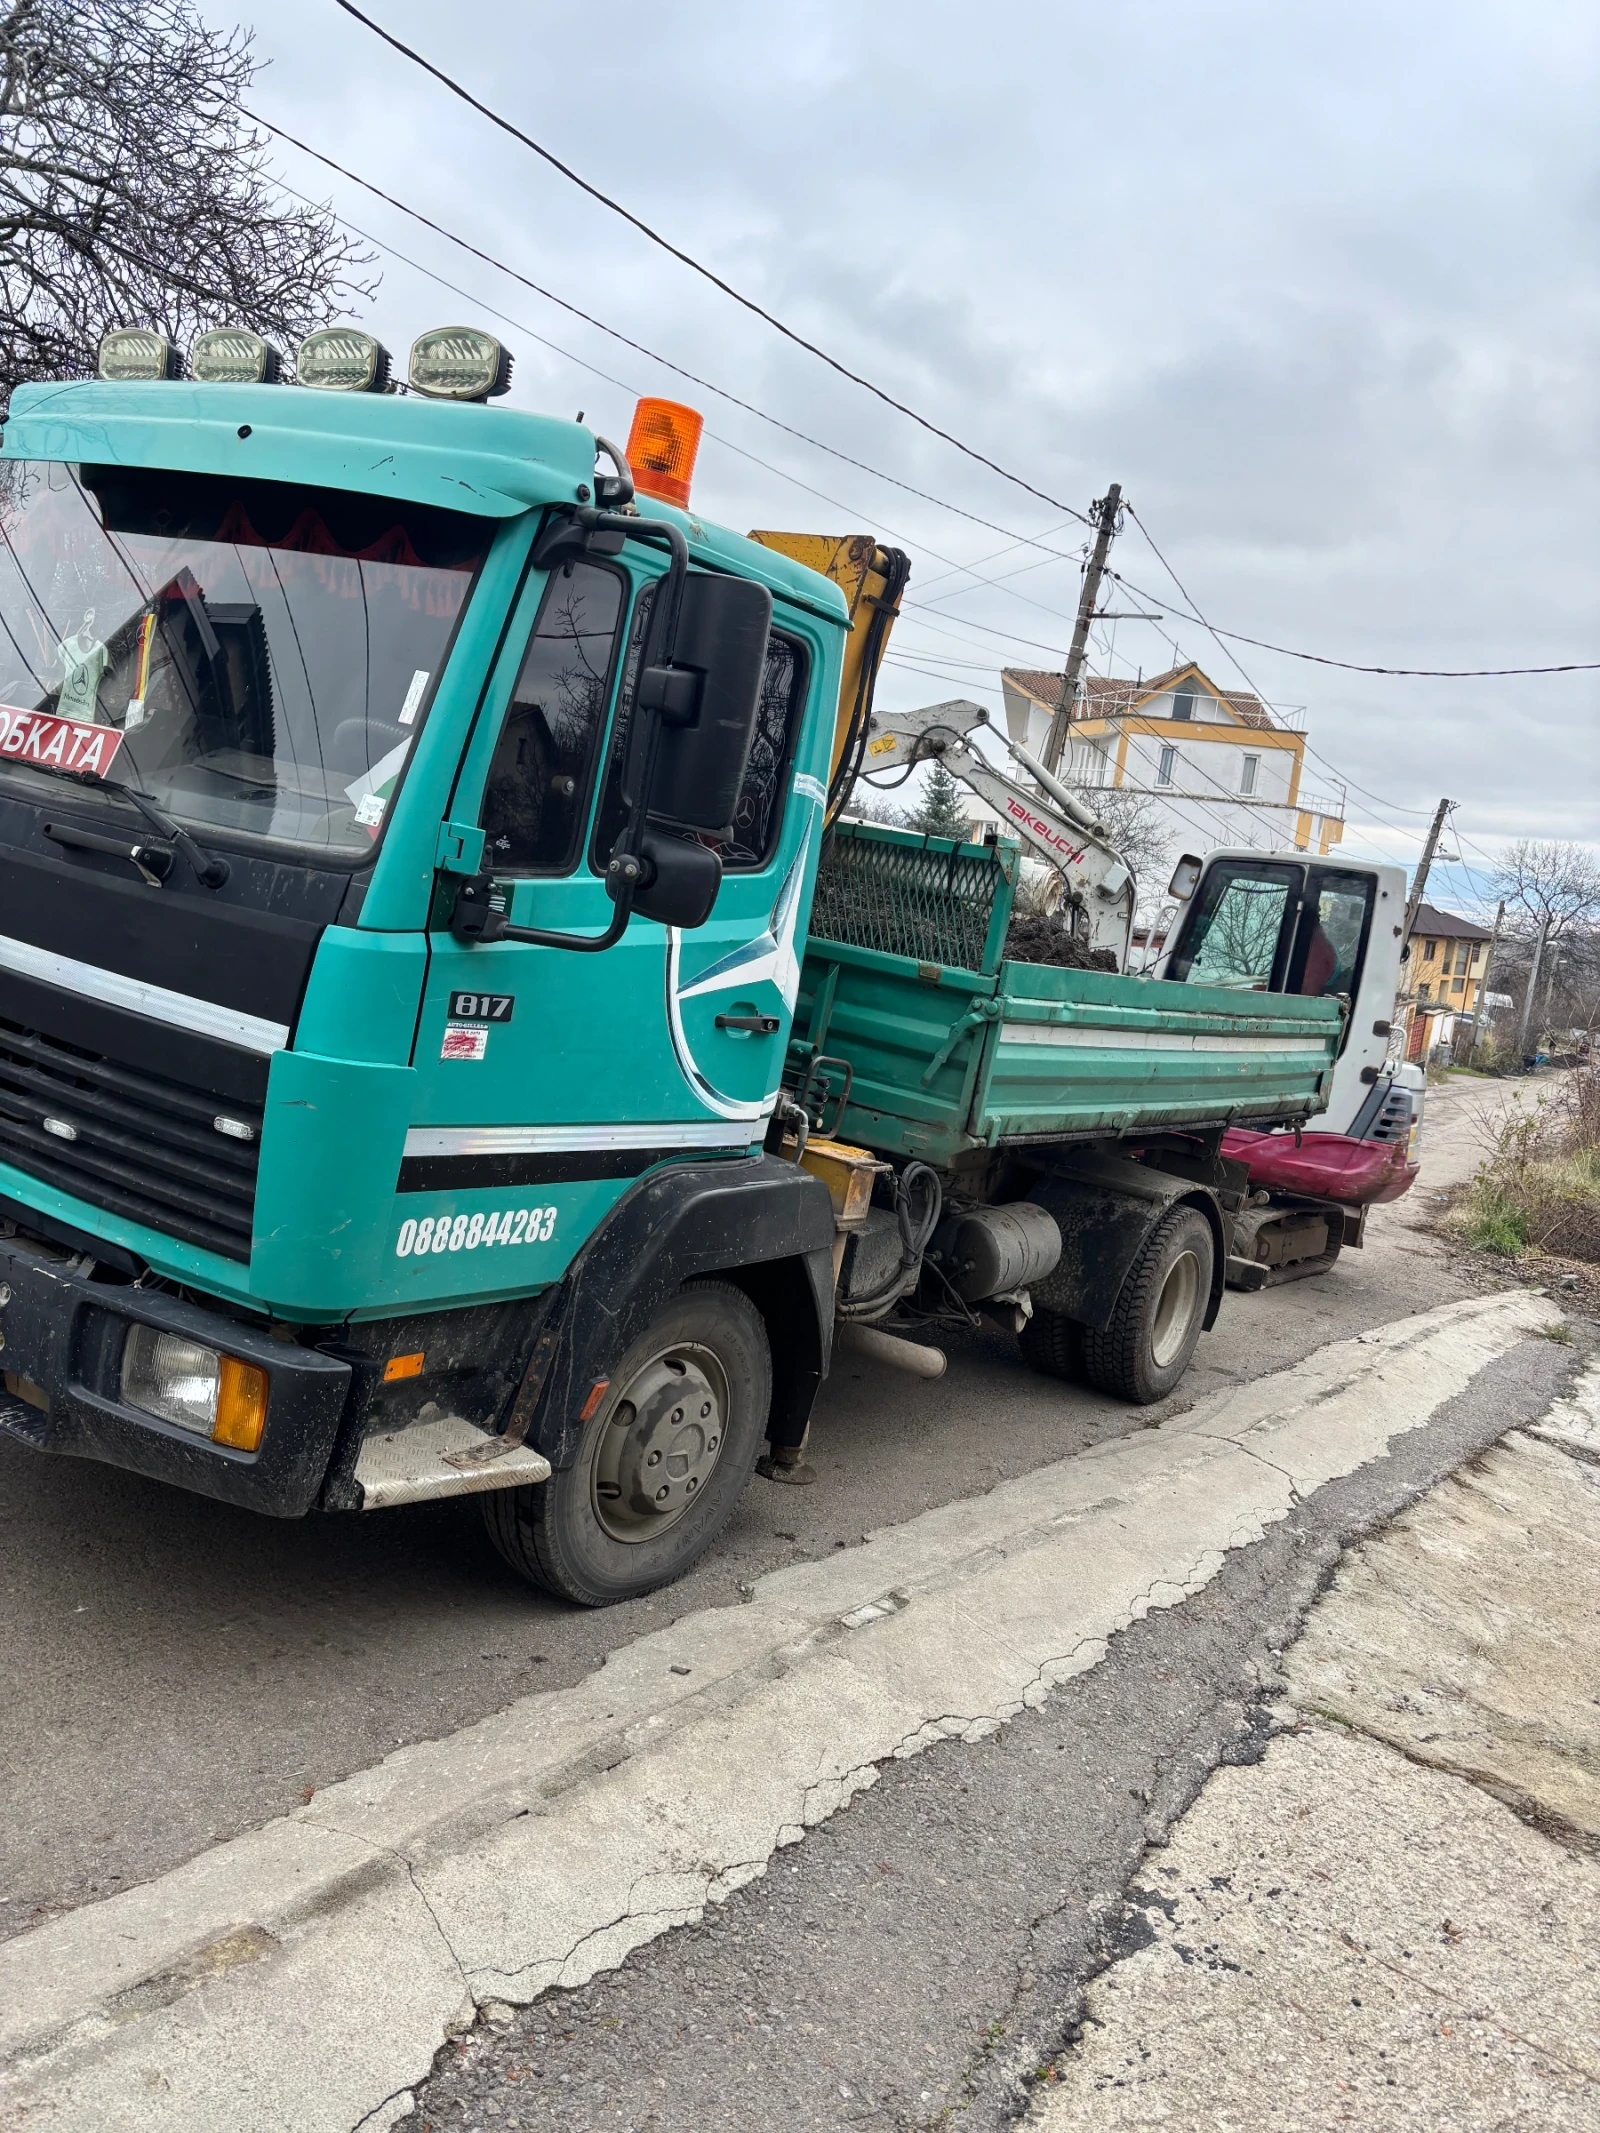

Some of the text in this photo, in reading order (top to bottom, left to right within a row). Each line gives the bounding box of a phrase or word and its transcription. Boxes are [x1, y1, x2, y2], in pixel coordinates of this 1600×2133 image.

[1006, 796, 1085, 864] TAKEUCHI
[455, 994, 511, 1017] 817
[396, 1207, 558, 1258] 0888844283
